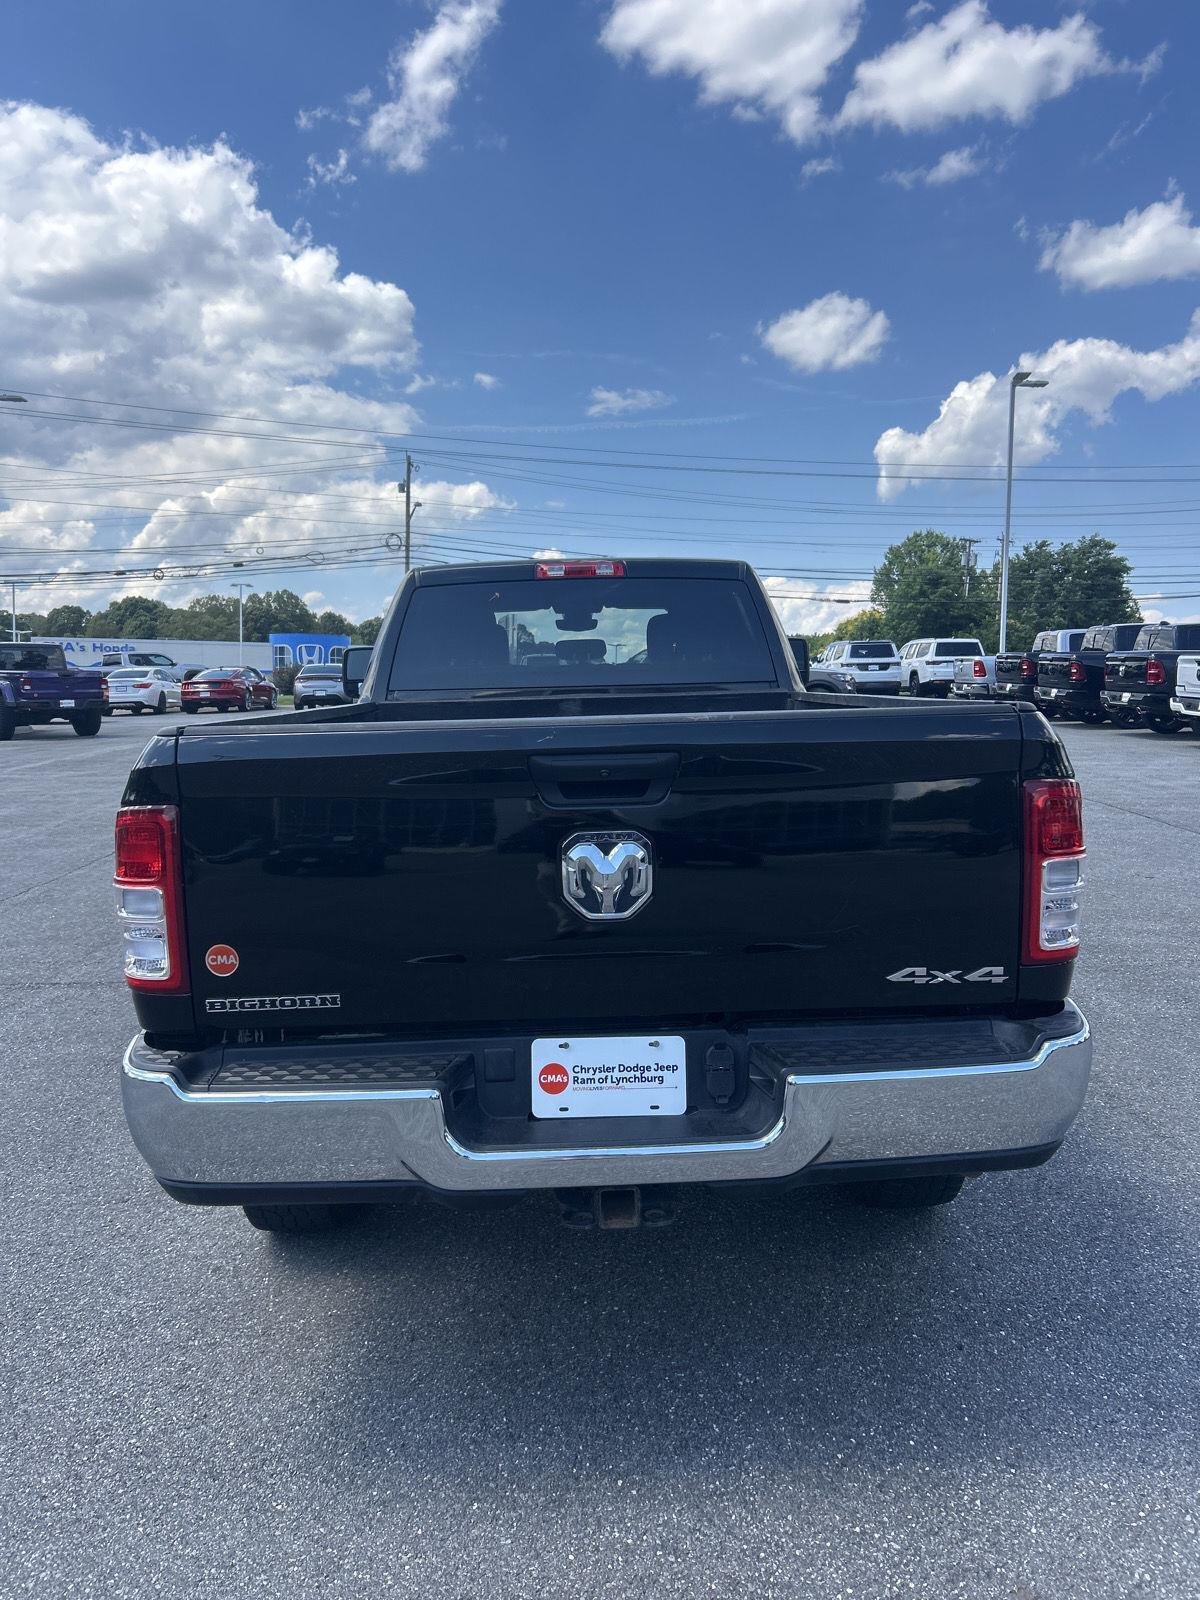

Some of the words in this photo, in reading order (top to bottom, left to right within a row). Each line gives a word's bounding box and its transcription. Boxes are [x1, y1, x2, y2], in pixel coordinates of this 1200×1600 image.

[207, 955, 237, 965] CMA
[572, 1064, 616, 1076] Chrysler
[618, 1064, 651, 1076] Dodge
[654, 1062, 679, 1075] Jeep
[540, 1074, 568, 1083] CMA's
[572, 1076, 596, 1085] Ram
[597, 1075, 609, 1084] of
[610, 1073, 665, 1086] Lynchburg
